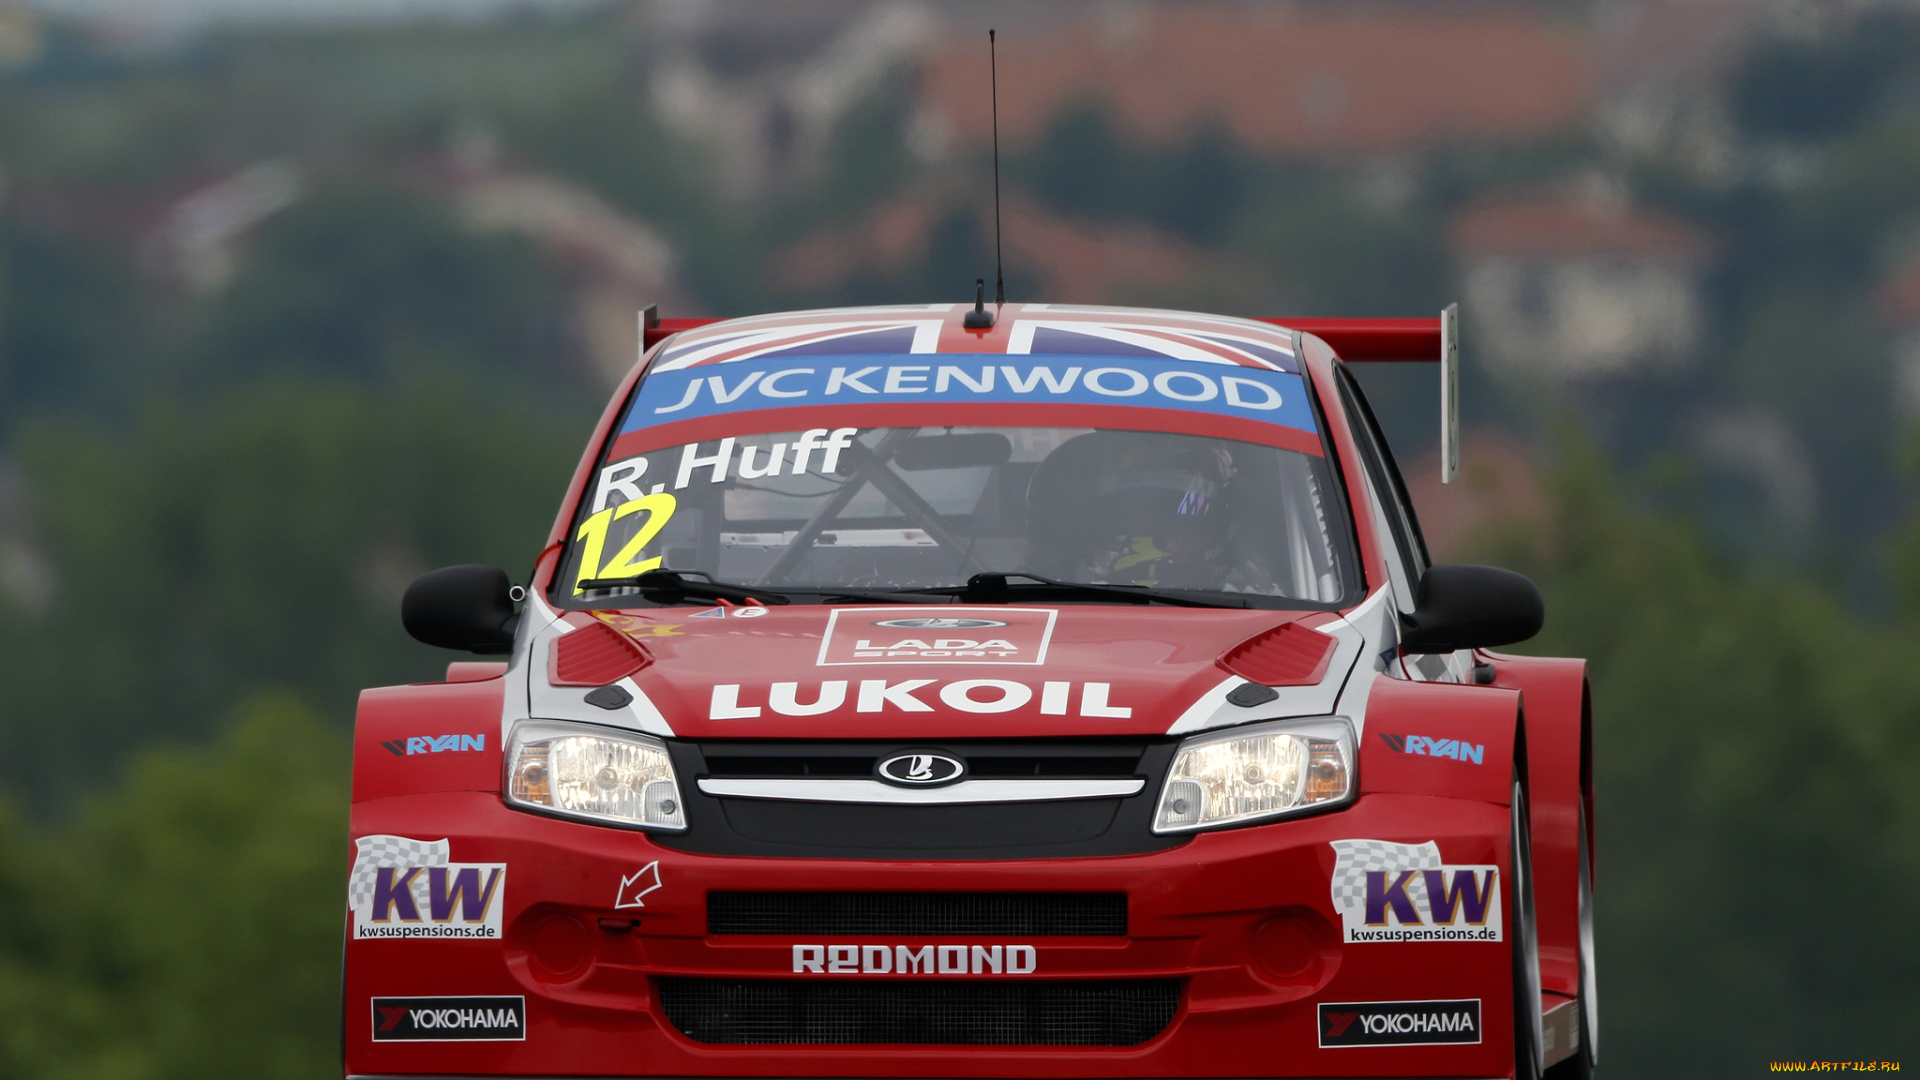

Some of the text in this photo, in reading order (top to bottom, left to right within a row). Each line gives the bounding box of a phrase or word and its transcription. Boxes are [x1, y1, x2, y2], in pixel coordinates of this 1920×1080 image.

[654, 365, 1283, 415] JVC KENWOOD
[592, 427, 858, 514] R.Huff
[573, 492, 677, 597] 12
[855, 639, 1018, 650] LADA
[709, 679, 1133, 719] LUKOIL
[406, 734, 485, 755] RYAN
[1405, 735, 1484, 765] RYAN
[371, 867, 504, 923] KW
[1364, 870, 1498, 926] KW
[359, 924, 496, 938] kwsuspensions.de
[1350, 927, 1497, 941] kwsuspensions.de
[409, 1009, 519, 1029] YOKOHAMA
[1359, 1012, 1475, 1033] YOKOHAMA
